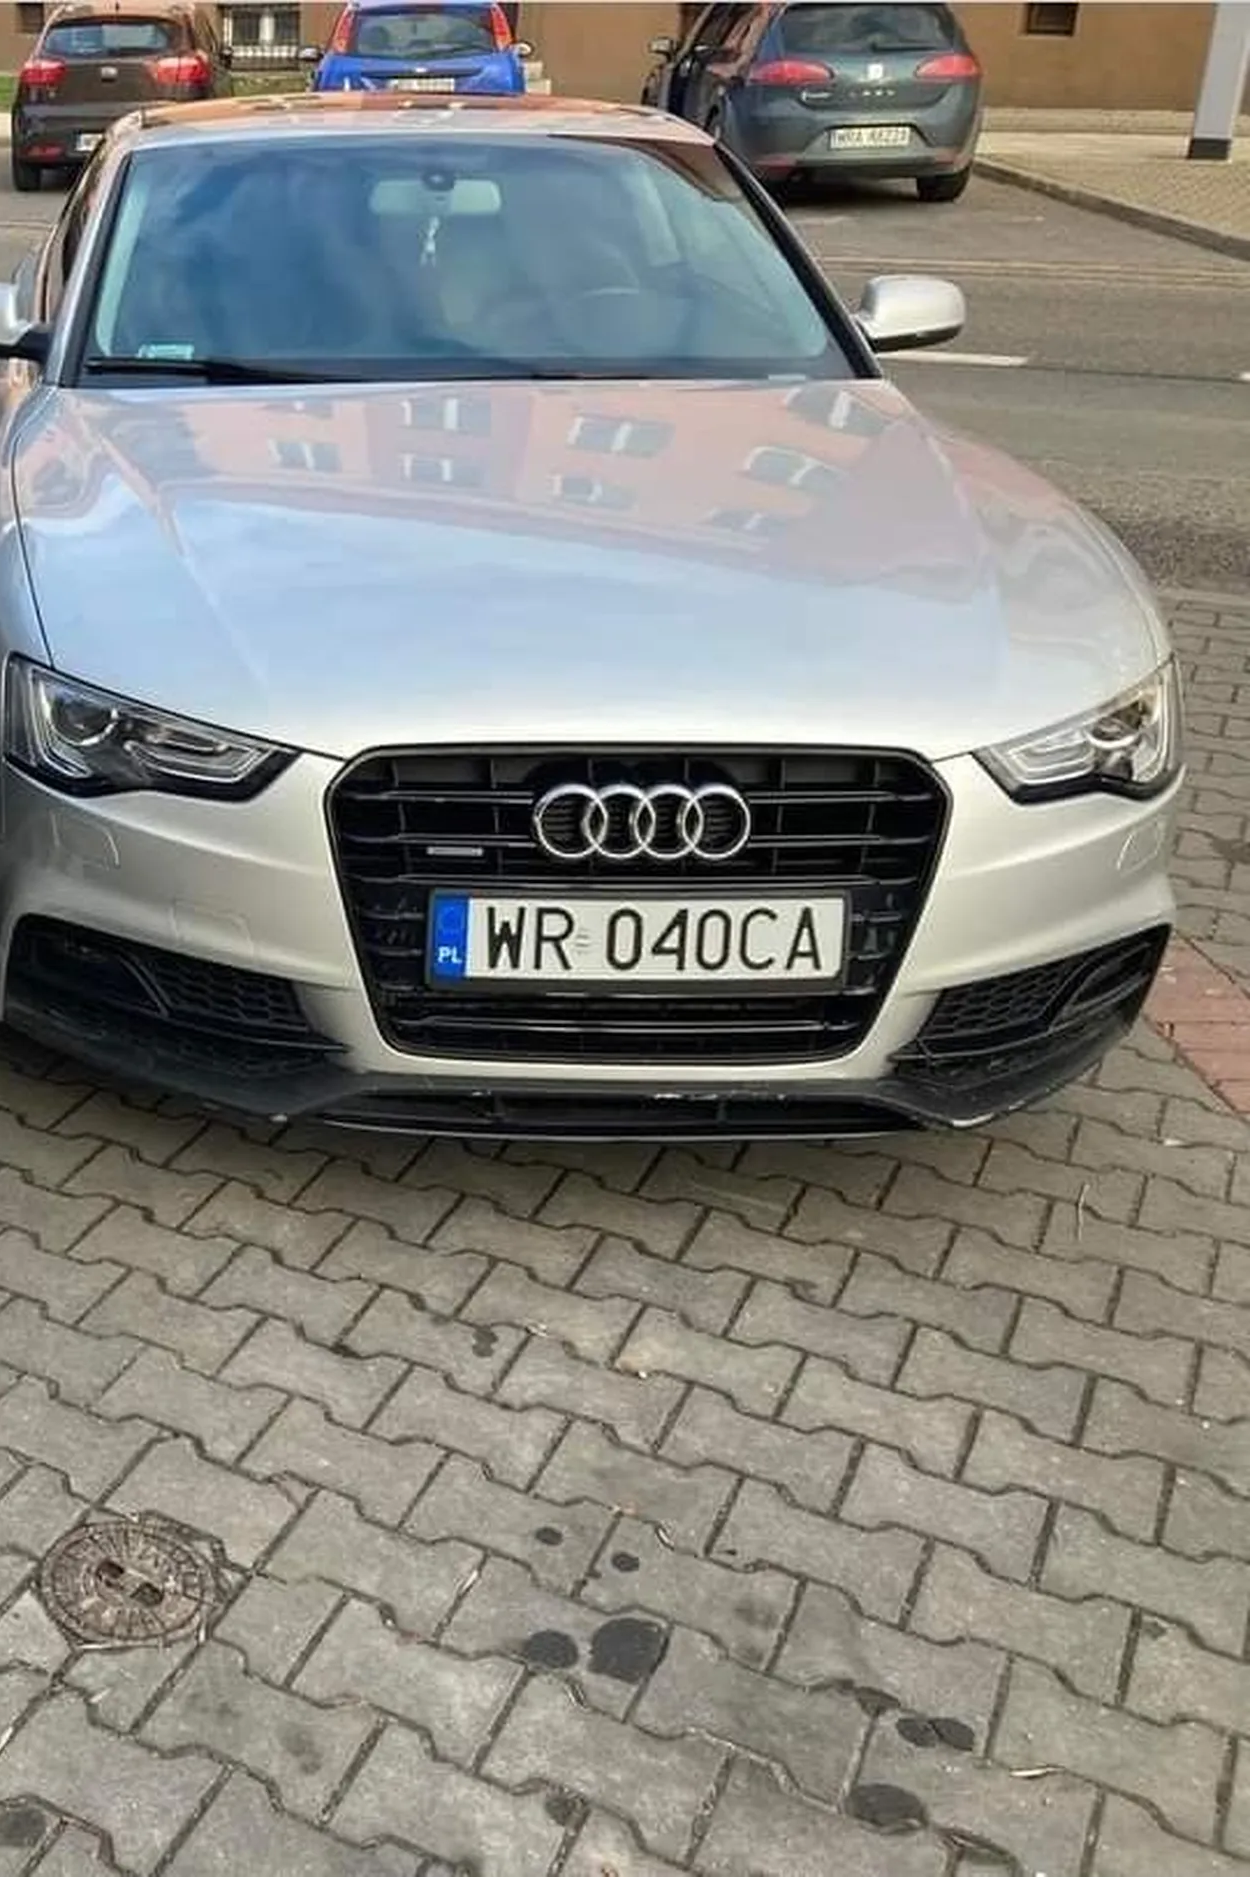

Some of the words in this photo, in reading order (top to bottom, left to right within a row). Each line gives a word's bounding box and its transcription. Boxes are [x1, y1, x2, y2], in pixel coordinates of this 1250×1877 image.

[437, 947, 463, 963] PL
[486, 906, 575, 971] WR
[606, 907, 822, 971] 040CA
